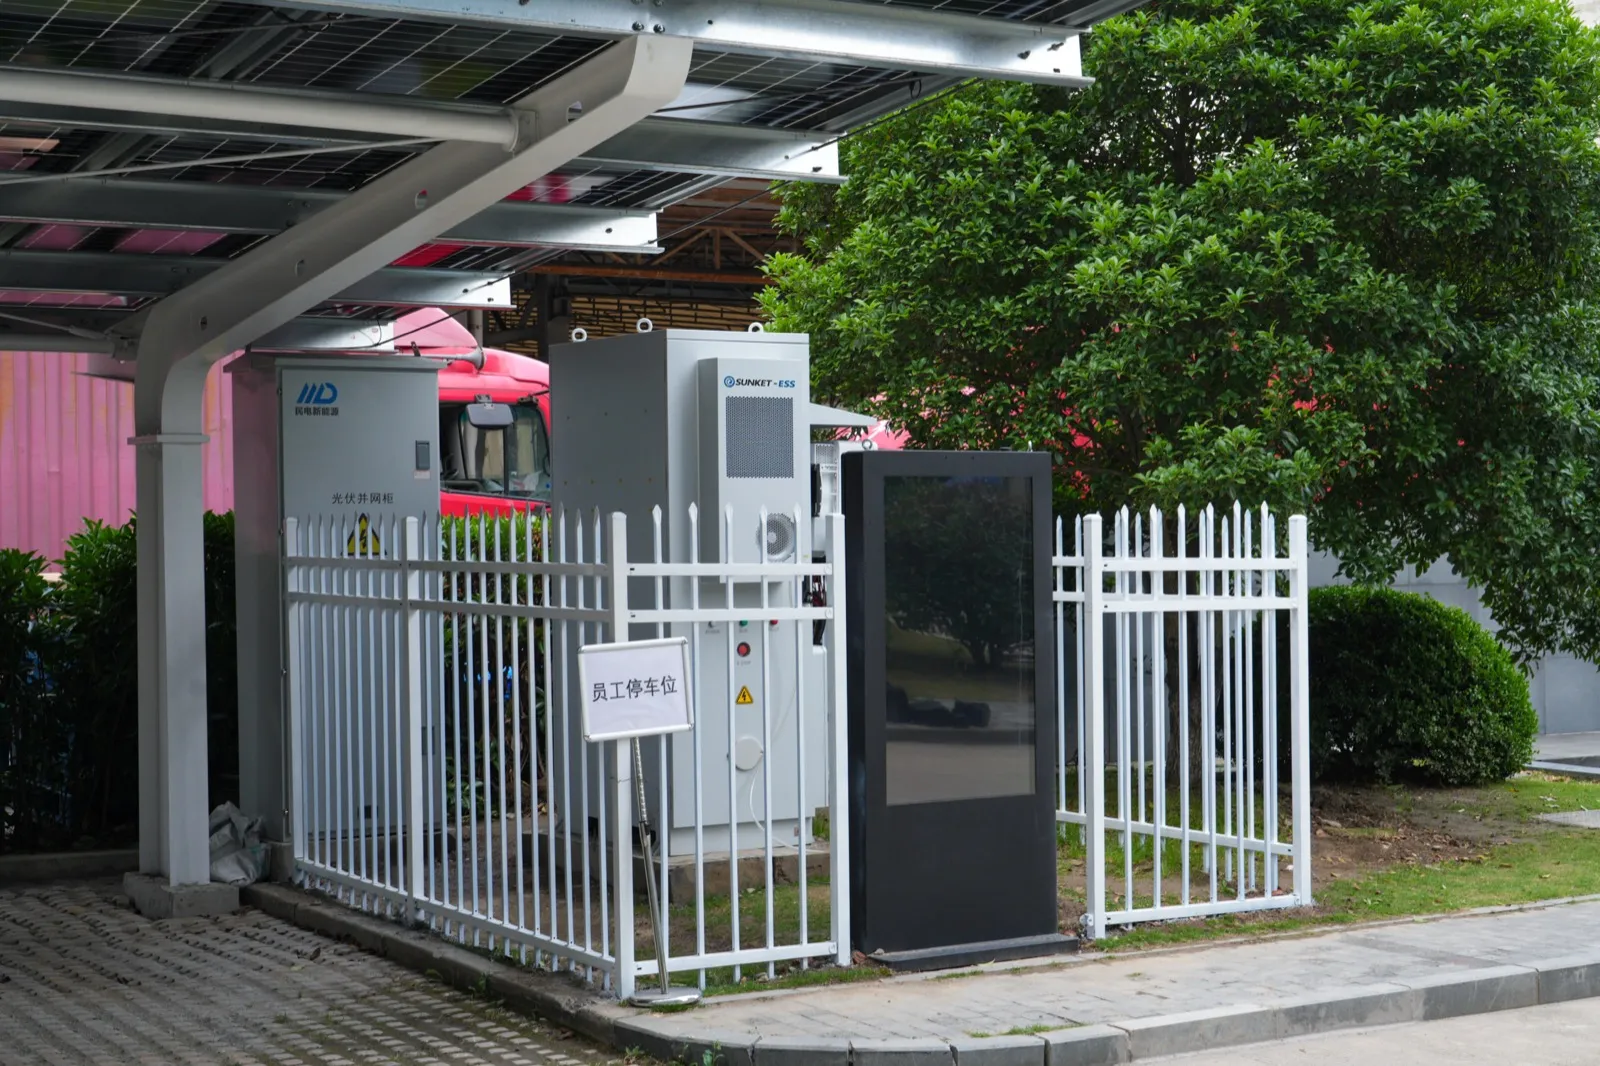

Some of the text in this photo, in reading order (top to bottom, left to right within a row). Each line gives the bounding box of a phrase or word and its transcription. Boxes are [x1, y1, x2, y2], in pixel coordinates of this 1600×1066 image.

[736, 378, 772, 387] SUNKET
[295, 406, 339, 416] 民电新能源
[332, 492, 394, 505] 光伏并网柜
[592, 675, 678, 702] 员工停车位
